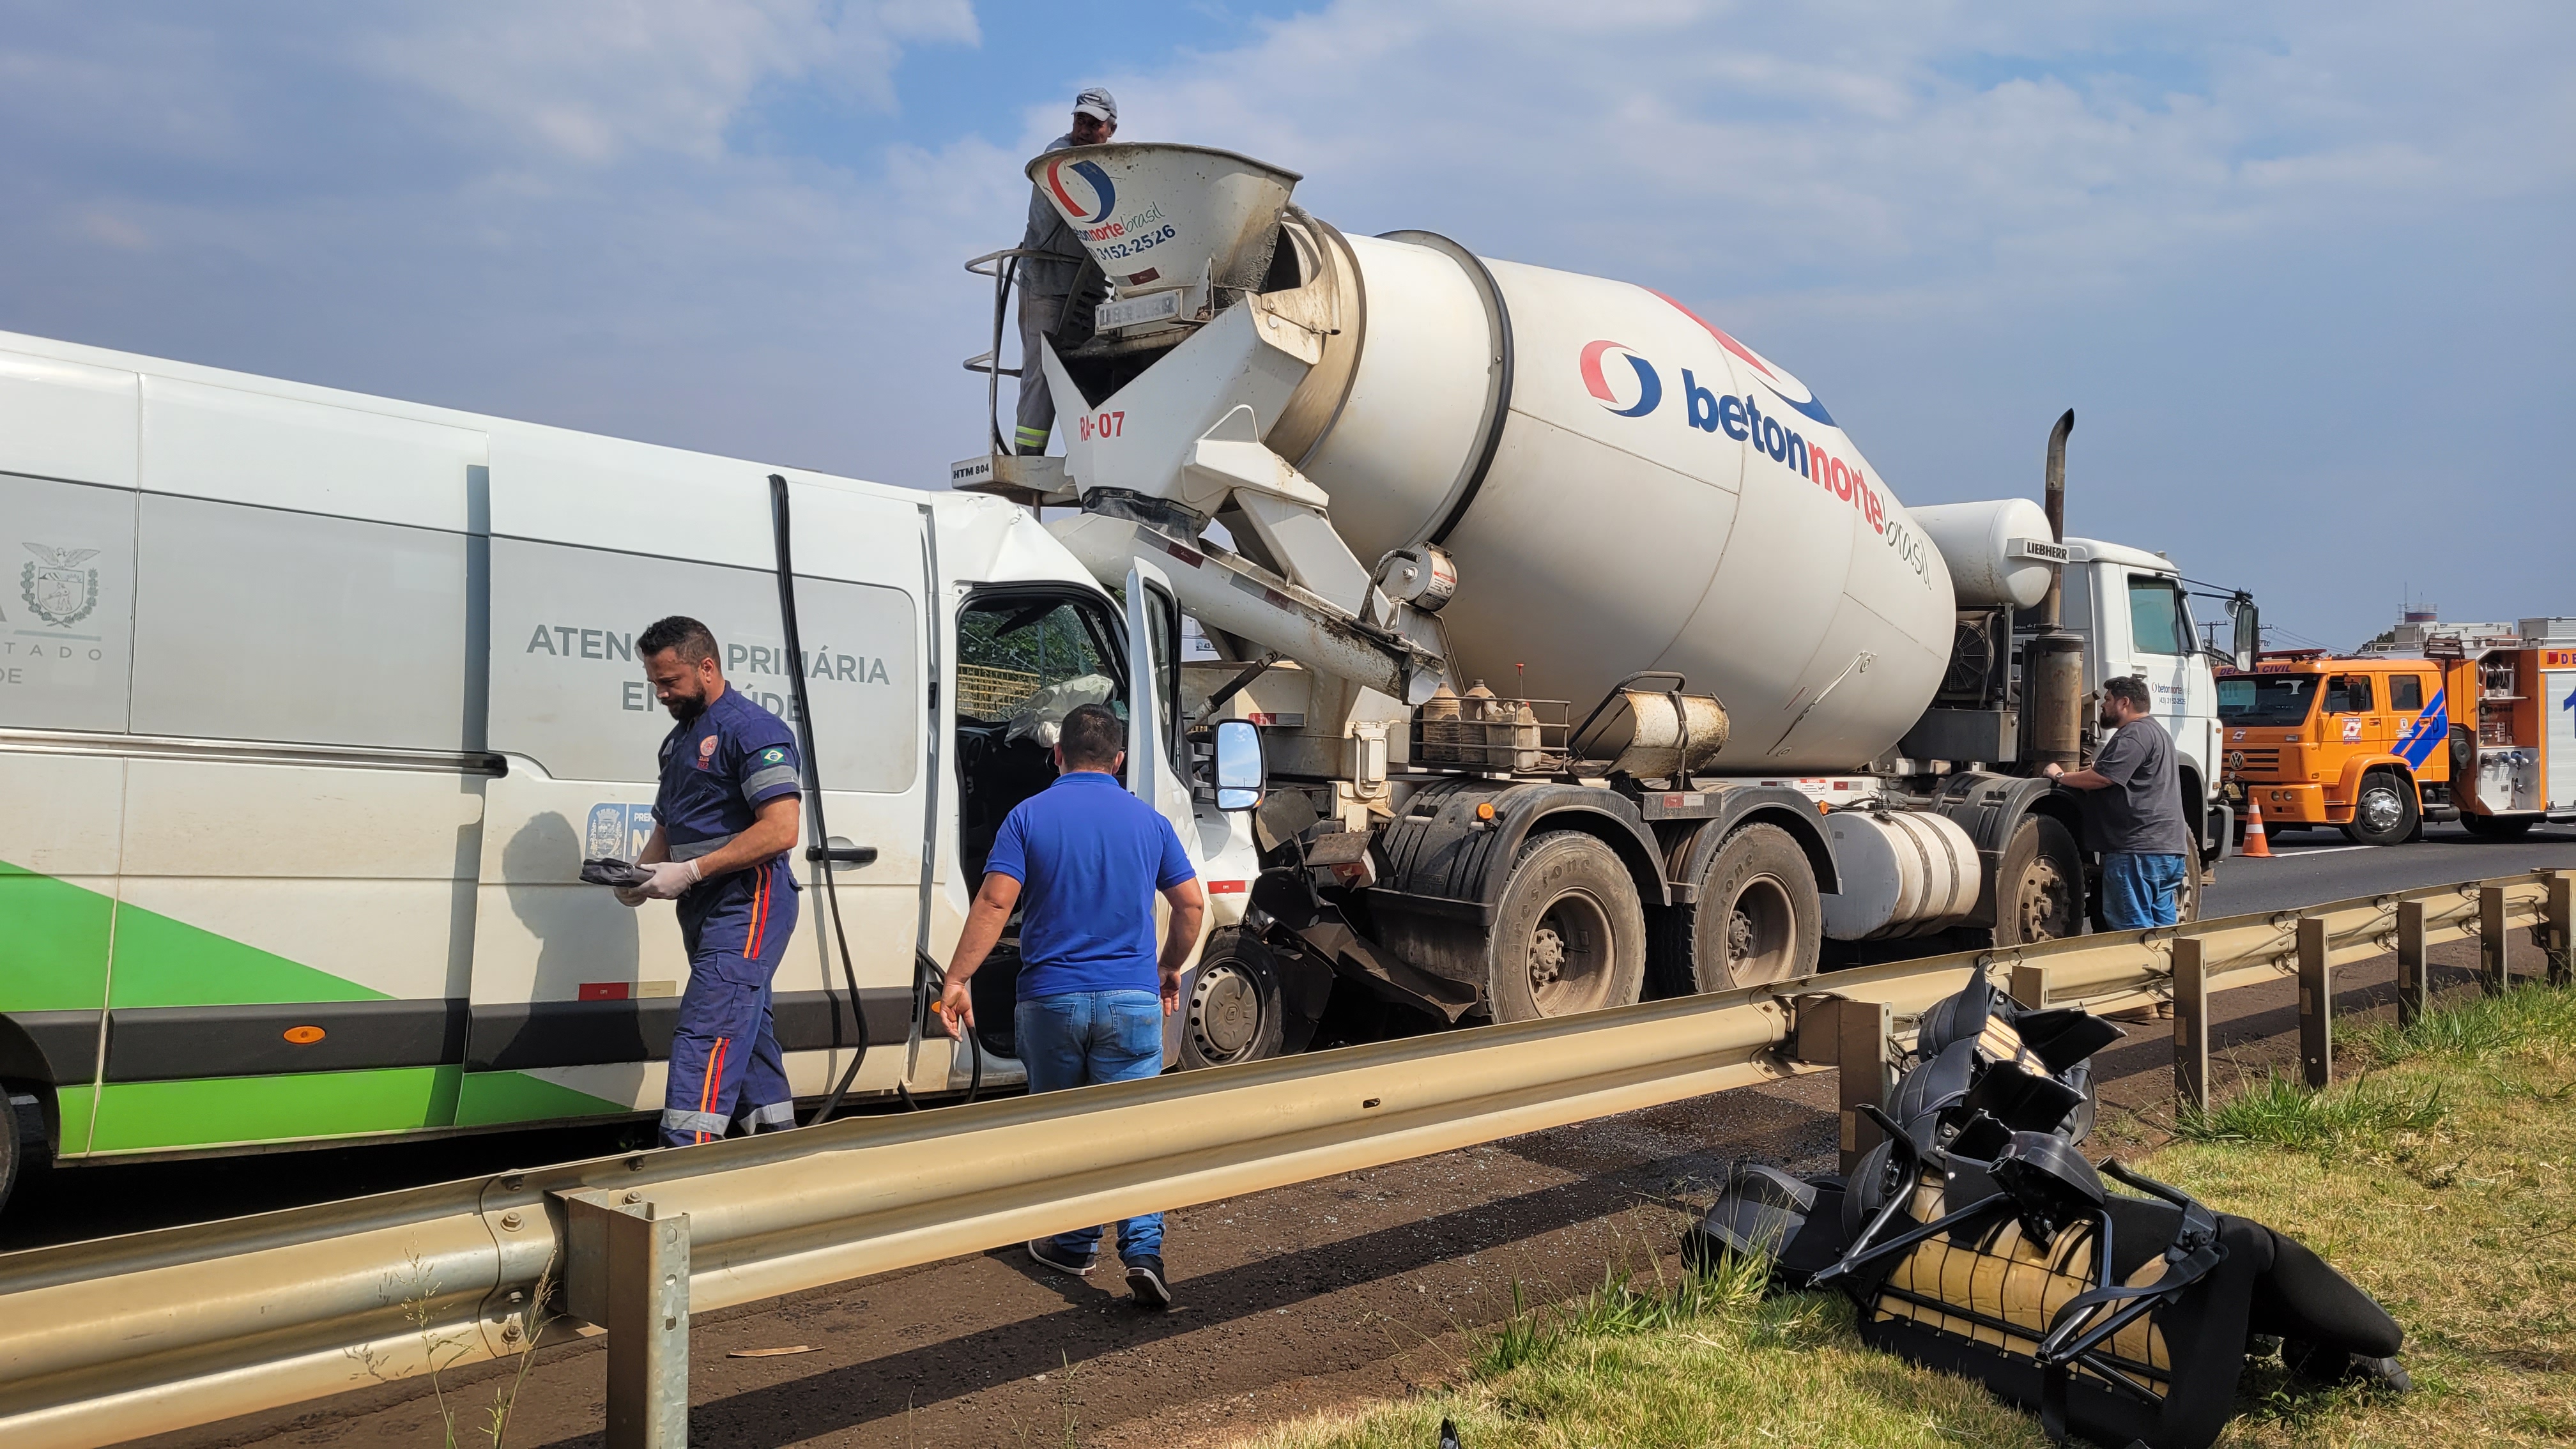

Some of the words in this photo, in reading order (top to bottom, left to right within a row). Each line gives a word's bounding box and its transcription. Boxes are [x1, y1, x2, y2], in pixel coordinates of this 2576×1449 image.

[1096, 224, 1176, 260] 3152-2526
[953, 467, 974, 479] HTM
[976, 463, 989, 474] 804
[2027, 542, 2067, 560] LIEBHERR
[4, 642, 102, 661] TADO
[526, 624, 644, 668] ATEN
